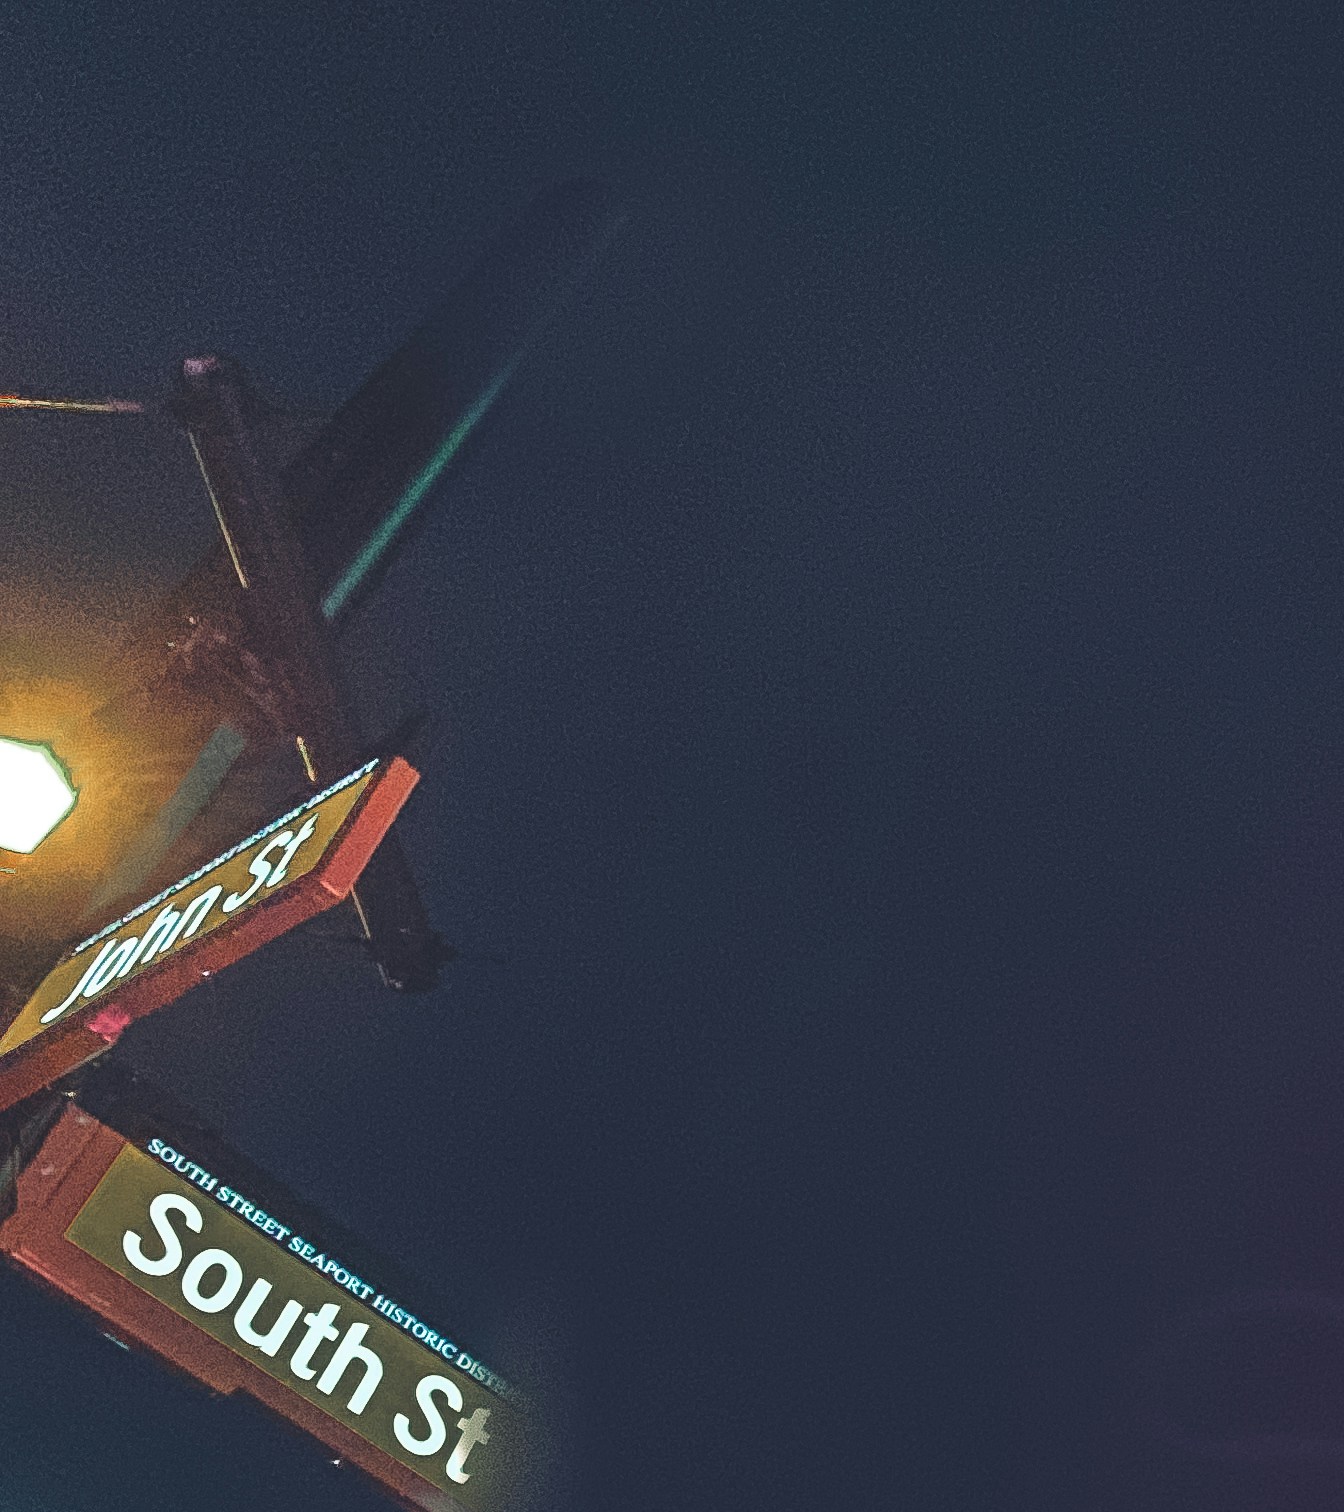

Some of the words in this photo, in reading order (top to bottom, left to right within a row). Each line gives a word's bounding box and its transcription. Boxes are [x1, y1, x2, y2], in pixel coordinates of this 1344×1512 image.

[40, 884, 222, 1024] John
[222, 812, 319, 913] St
[122, 1192, 384, 1417] South
[393, 1374, 491, 1486] St
[147, 1137, 219, 1192] SOUTH
[215, 1185, 292, 1241] STREET
[287, 1236, 376, 1300] SEAPORT
[371, 1294, 459, 1359] HISTORIC
